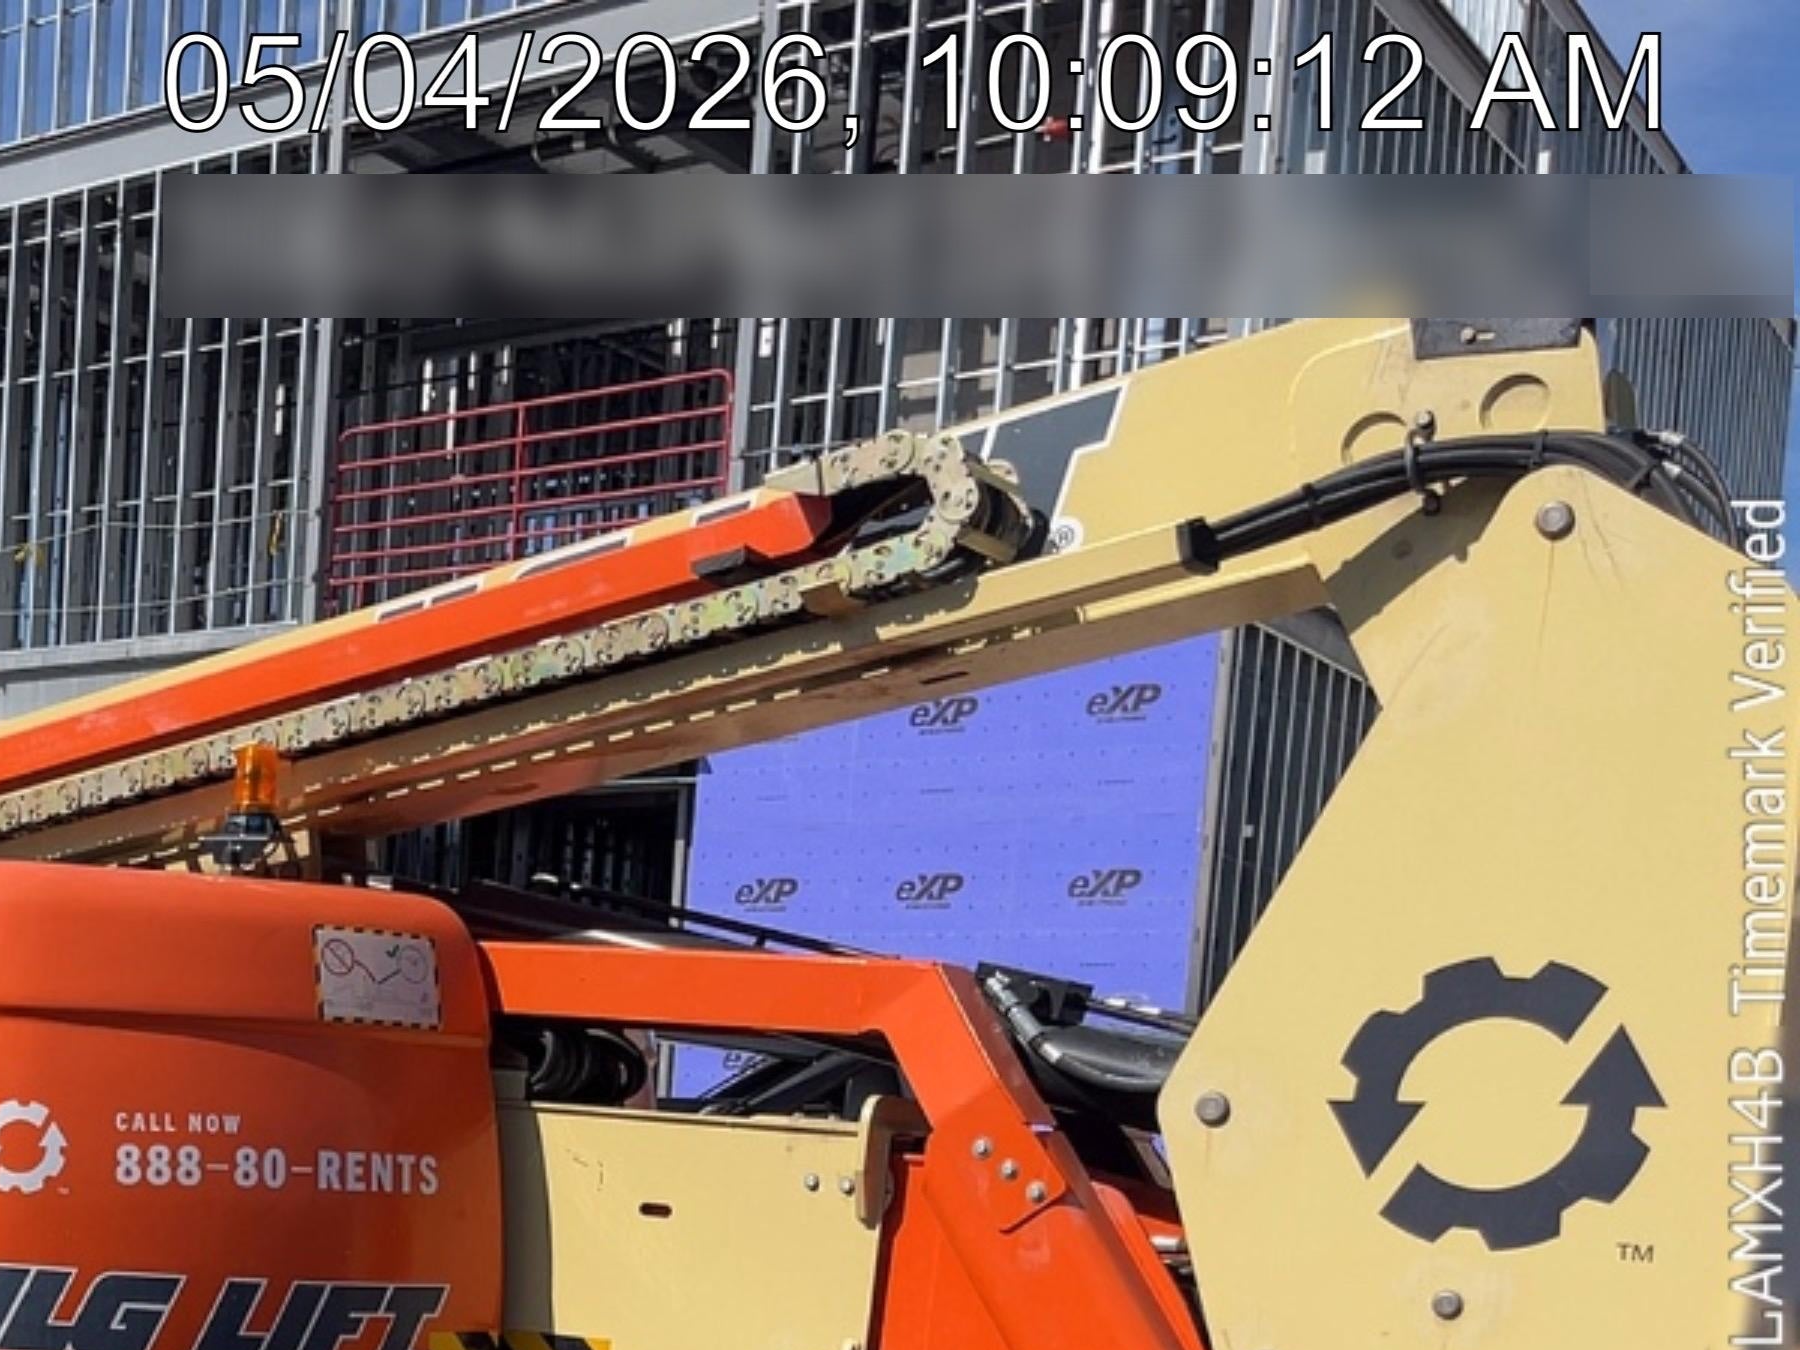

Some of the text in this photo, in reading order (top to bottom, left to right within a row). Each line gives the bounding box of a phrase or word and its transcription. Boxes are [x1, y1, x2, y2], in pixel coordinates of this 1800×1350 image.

[909, 697, 979, 727] eXP
[1085, 683, 1163, 716] eXP
[735, 878, 798, 904] eXP
[897, 873, 965, 902] eXP
[1068, 869, 1142, 899] eXP
[115, 1111, 241, 1135] CALL NOW
[114, 1142, 439, 1195] 888-80-RENTS
[1615, 1241, 1655, 1264] TM
